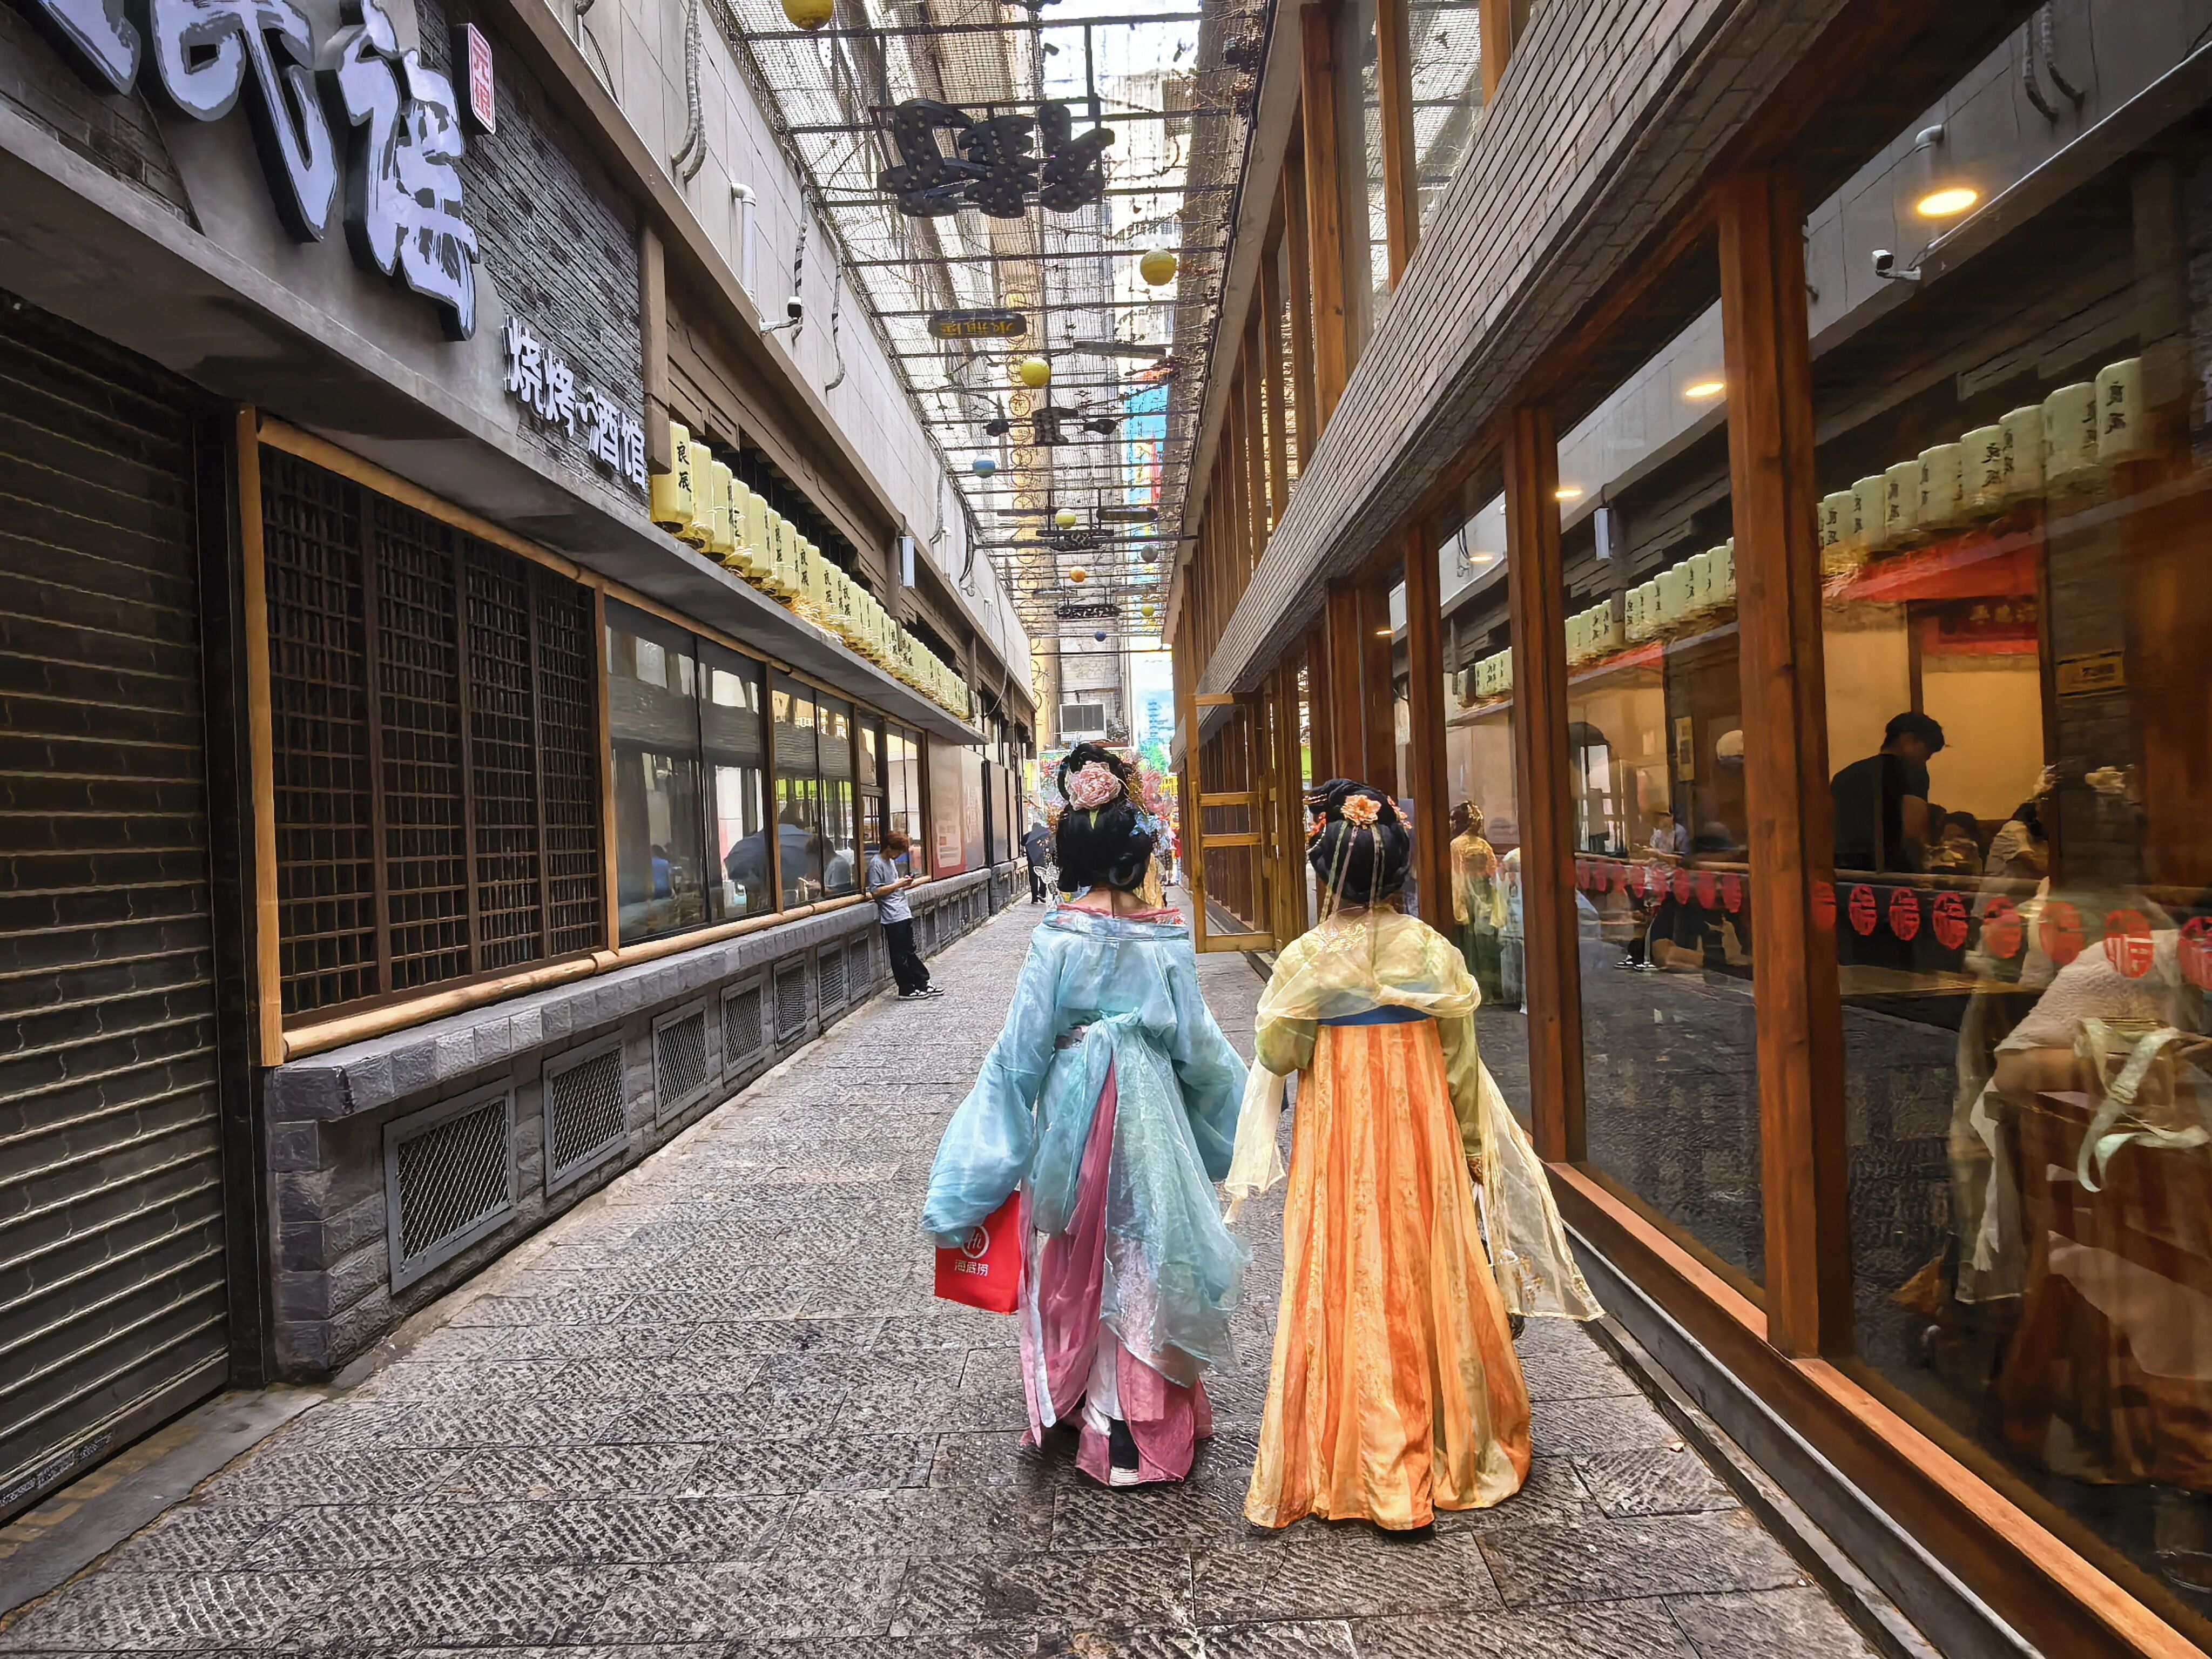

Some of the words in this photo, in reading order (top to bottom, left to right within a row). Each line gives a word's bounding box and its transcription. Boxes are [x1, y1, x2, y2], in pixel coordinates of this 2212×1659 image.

[677, 441, 692, 493] 良辰
[954, 1259, 989, 1277] 海底捞
